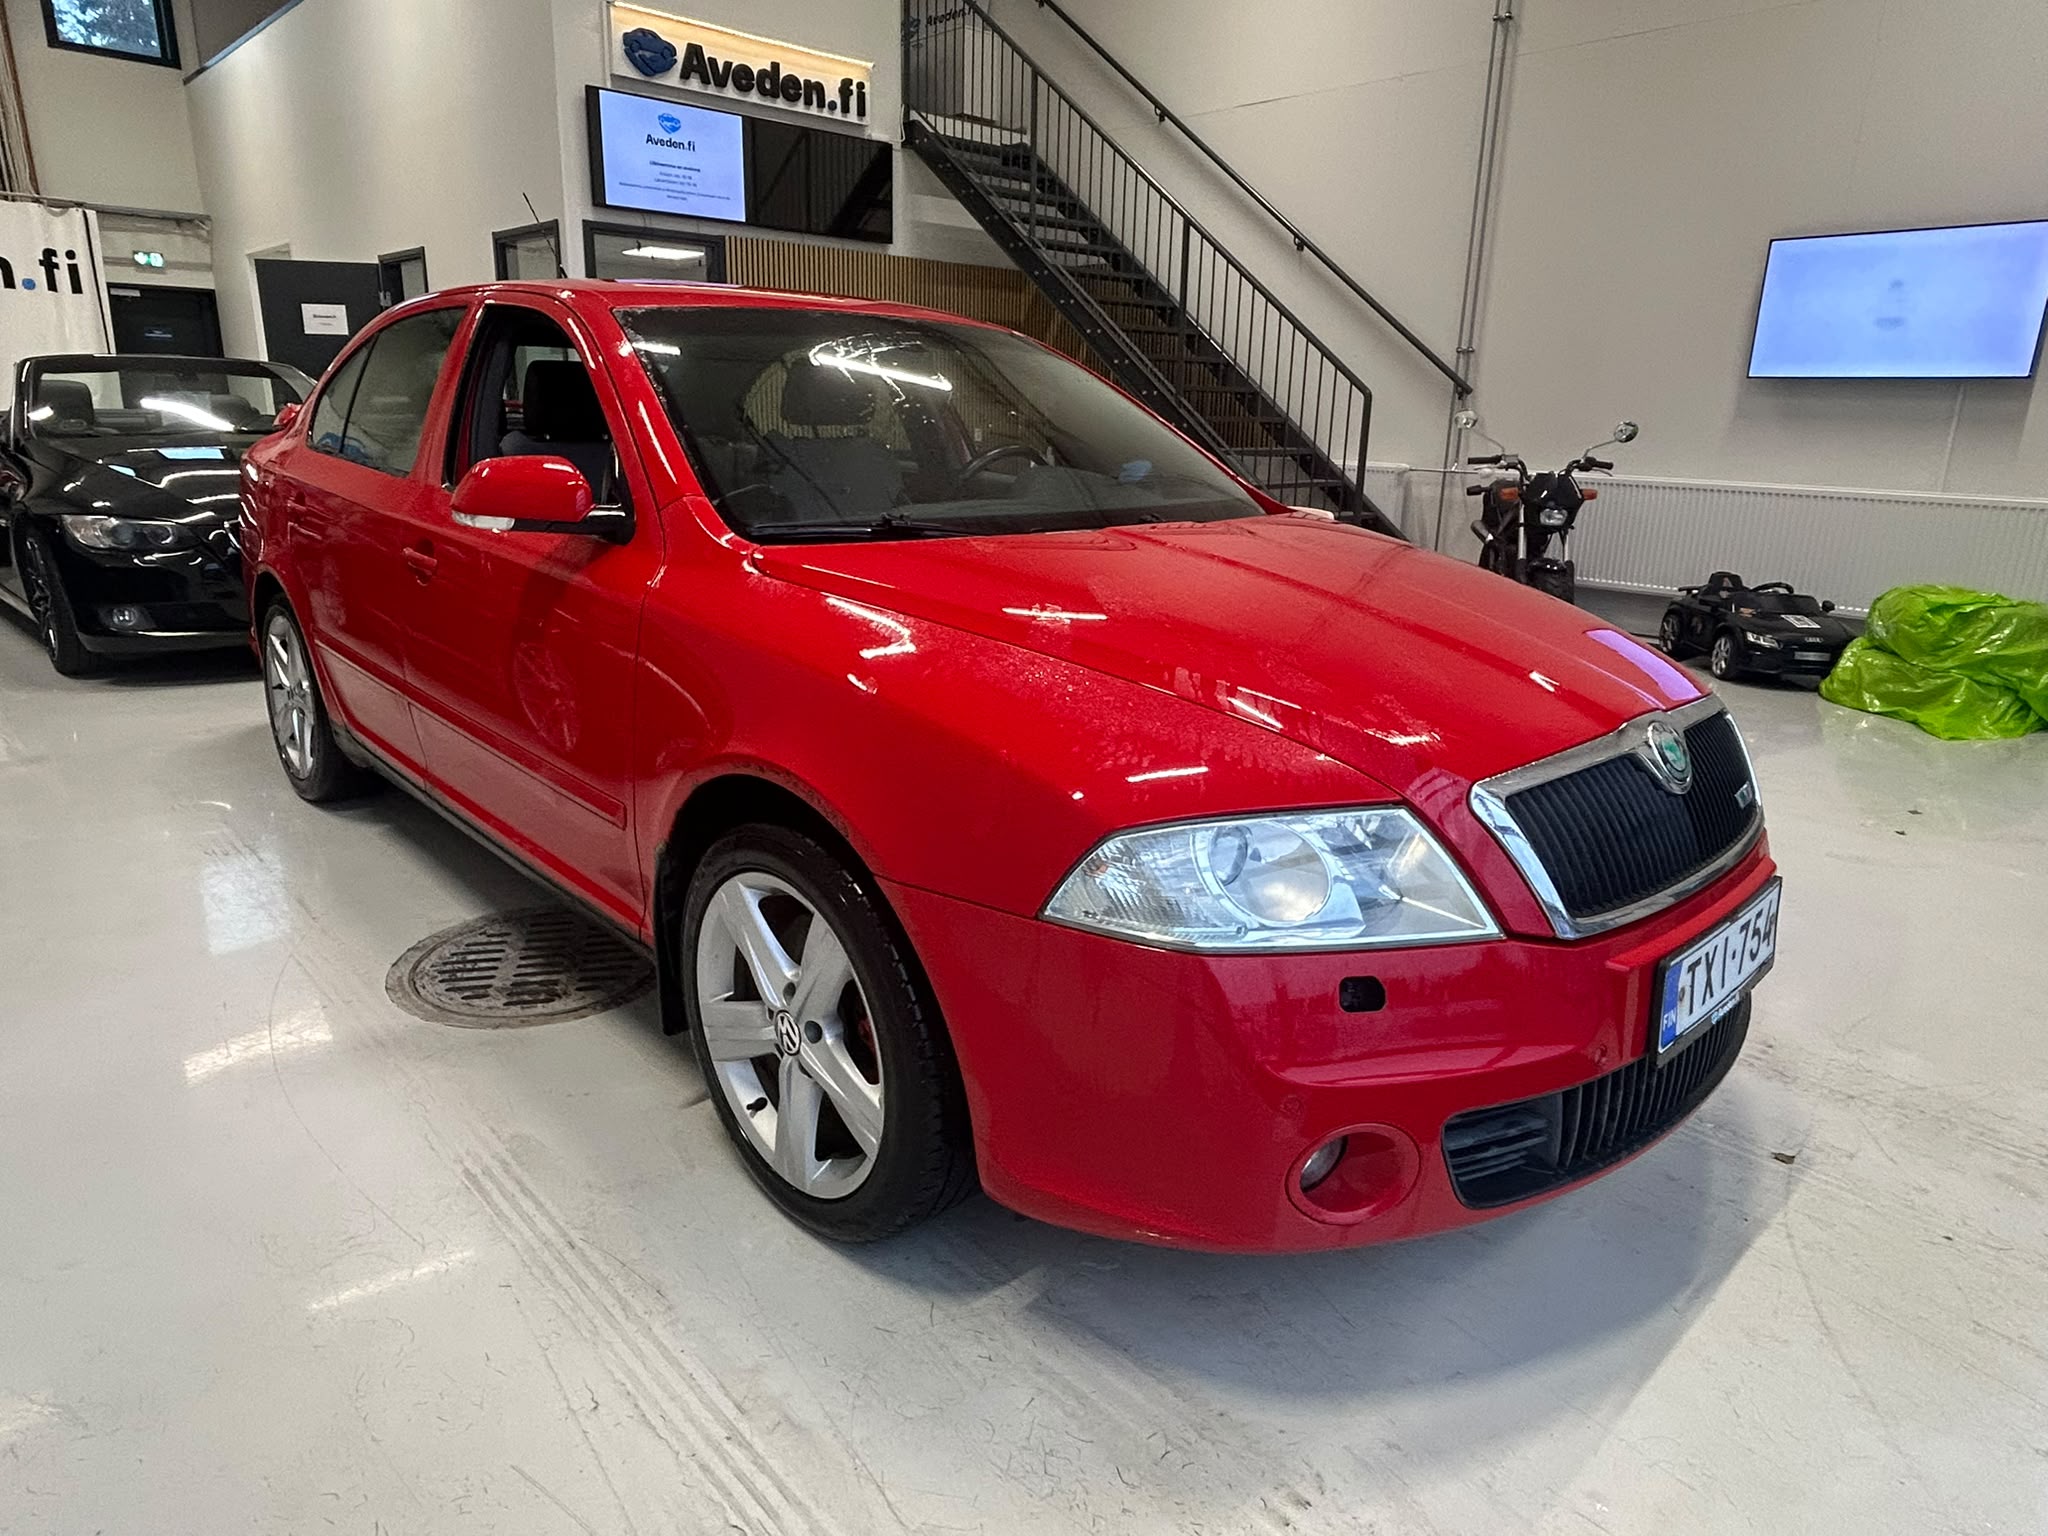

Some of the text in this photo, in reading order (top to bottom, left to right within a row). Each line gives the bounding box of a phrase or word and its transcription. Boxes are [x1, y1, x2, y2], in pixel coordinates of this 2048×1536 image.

[679, 42, 867, 117] Aveden.fi
[645, 133, 696, 152] Aveden.fi
[1686, 899, 1773, 1016] TXI-754
[1662, 1009, 1677, 1031] FIN
